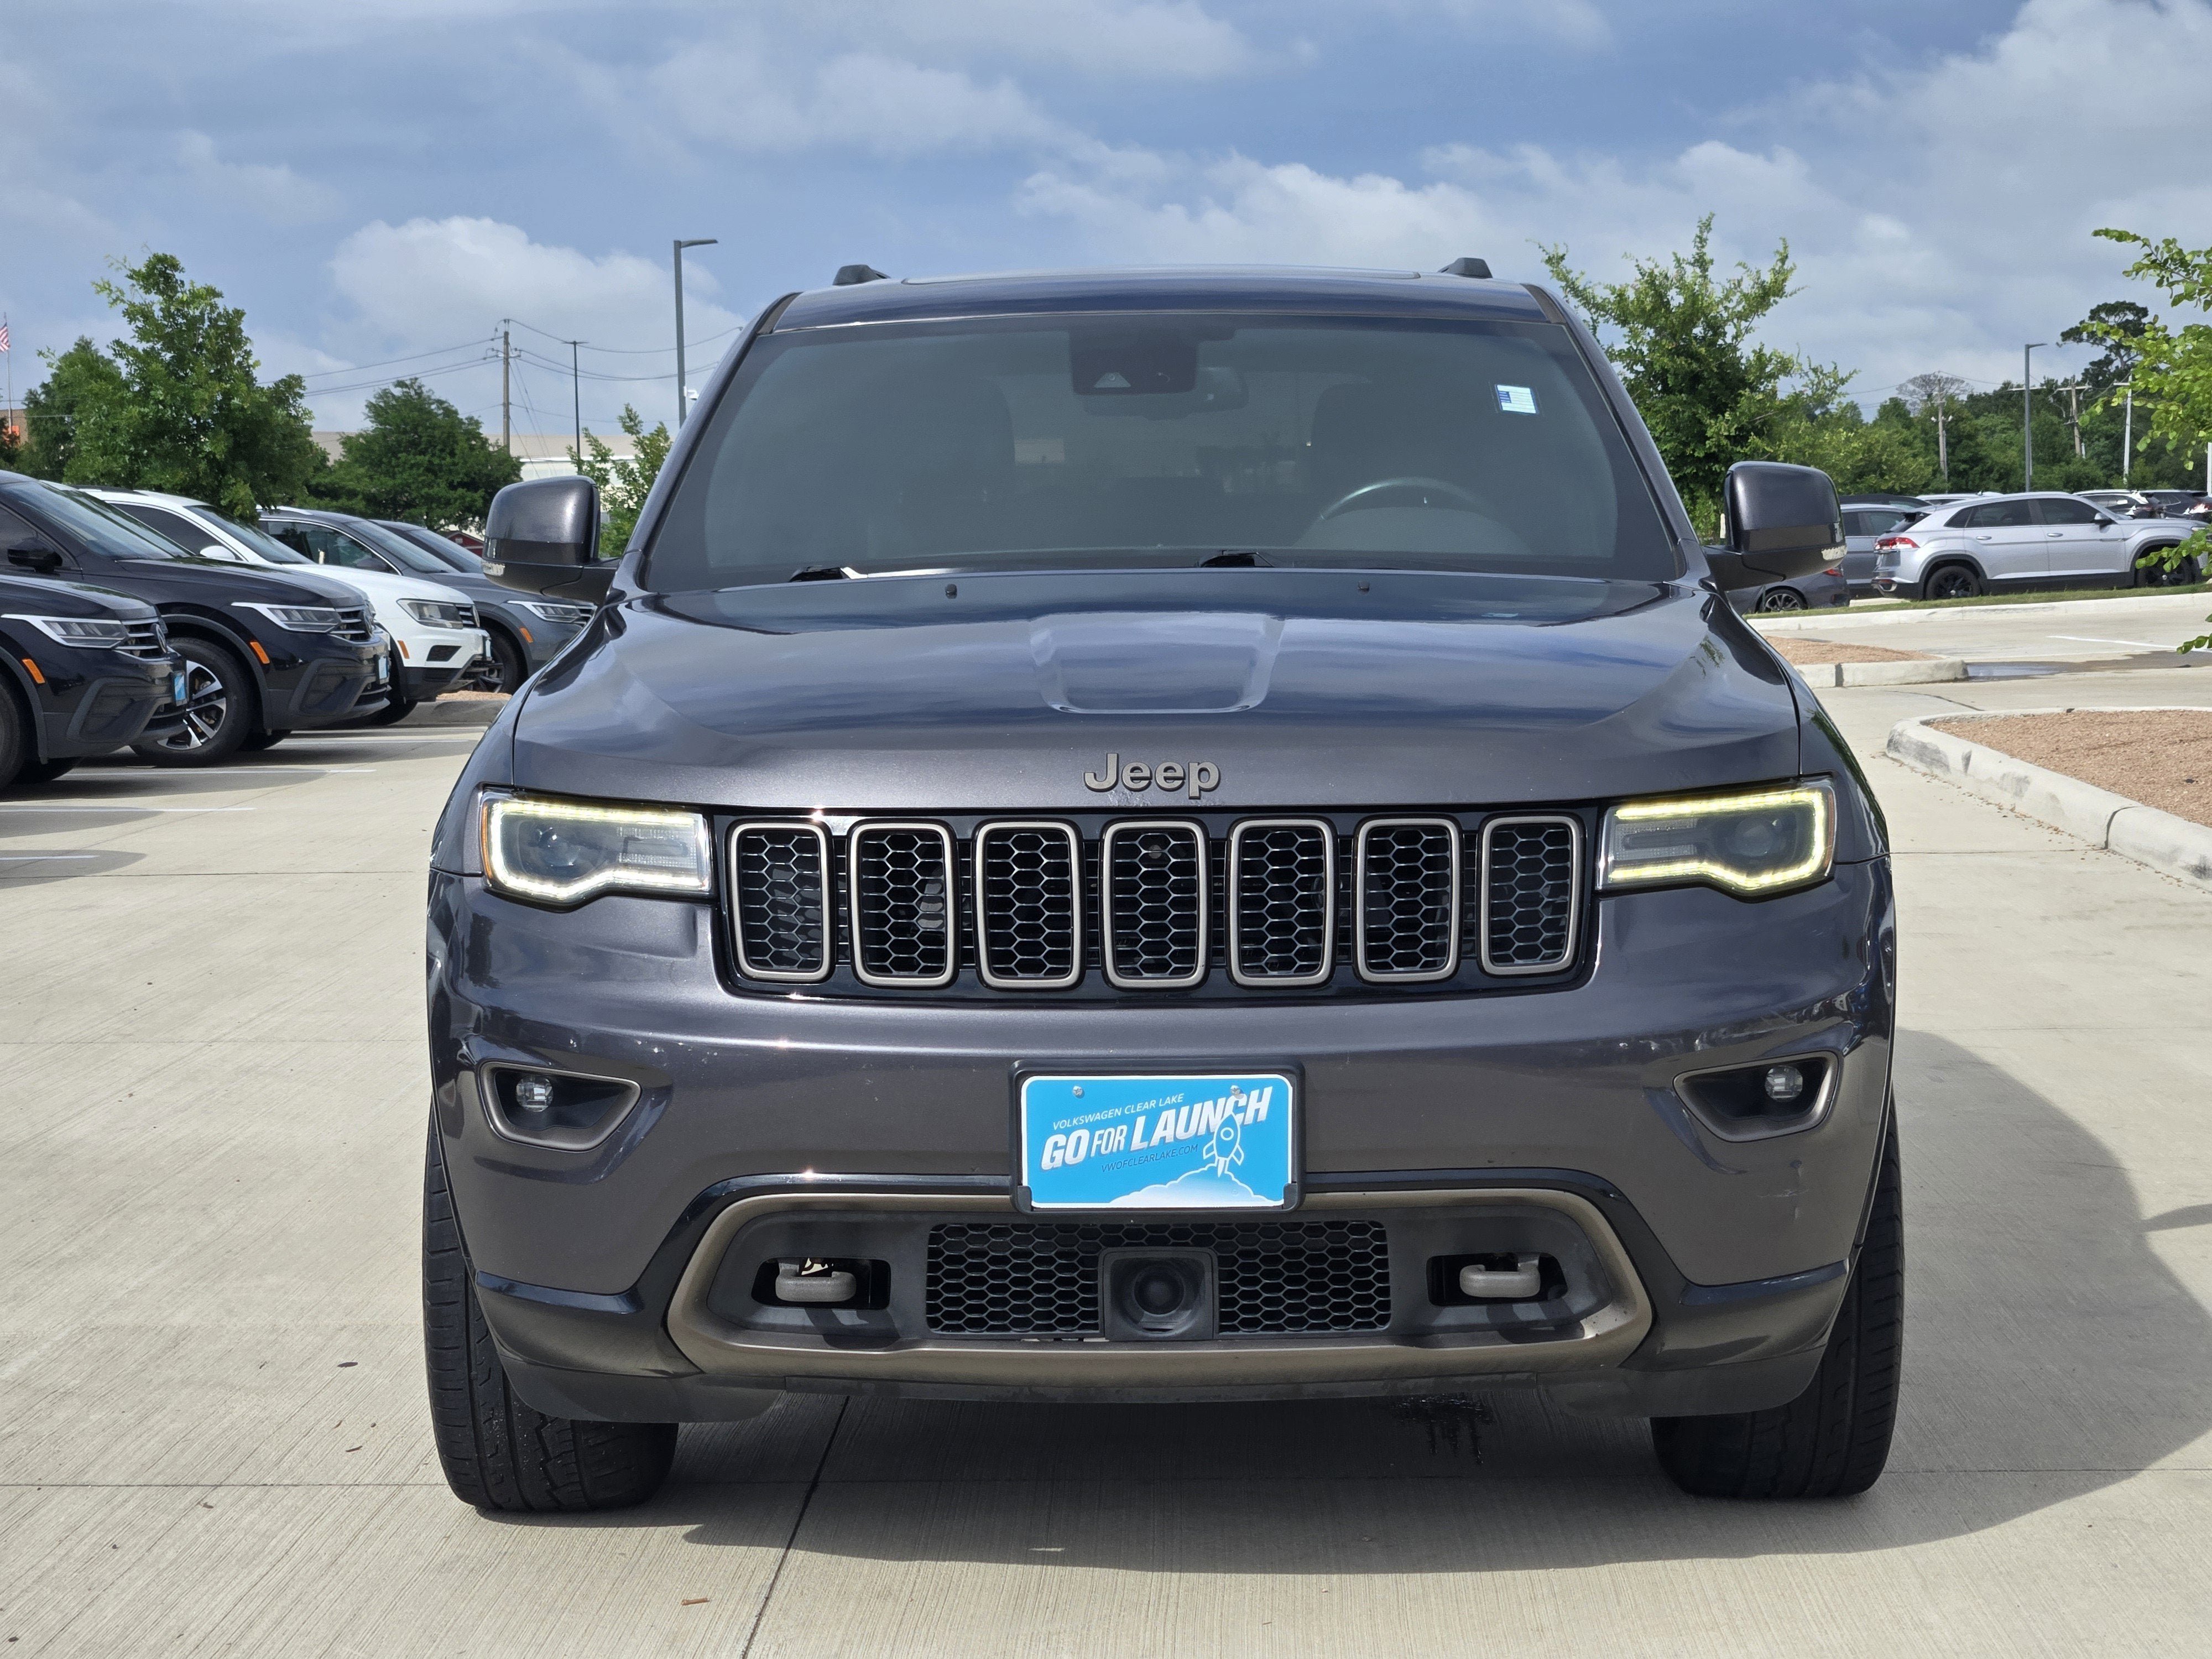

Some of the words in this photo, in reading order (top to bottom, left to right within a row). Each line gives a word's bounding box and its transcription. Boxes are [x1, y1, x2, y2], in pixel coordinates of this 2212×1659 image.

[1083, 753, 1220, 800] Jeep
[1041, 1129, 1090, 1170] GO
[1091, 1125, 1127, 1156] FOR
[1130, 1086, 1273, 1152] LAUNCH
[1053, 1108, 1121, 1130] VOLKSWAGEN
[1124, 1100, 1156, 1115] CLEAR
[1159, 1093, 1184, 1107] LAKE
[1101, 1144, 1198, 1172] VWOFCLEARLAKE.COM
